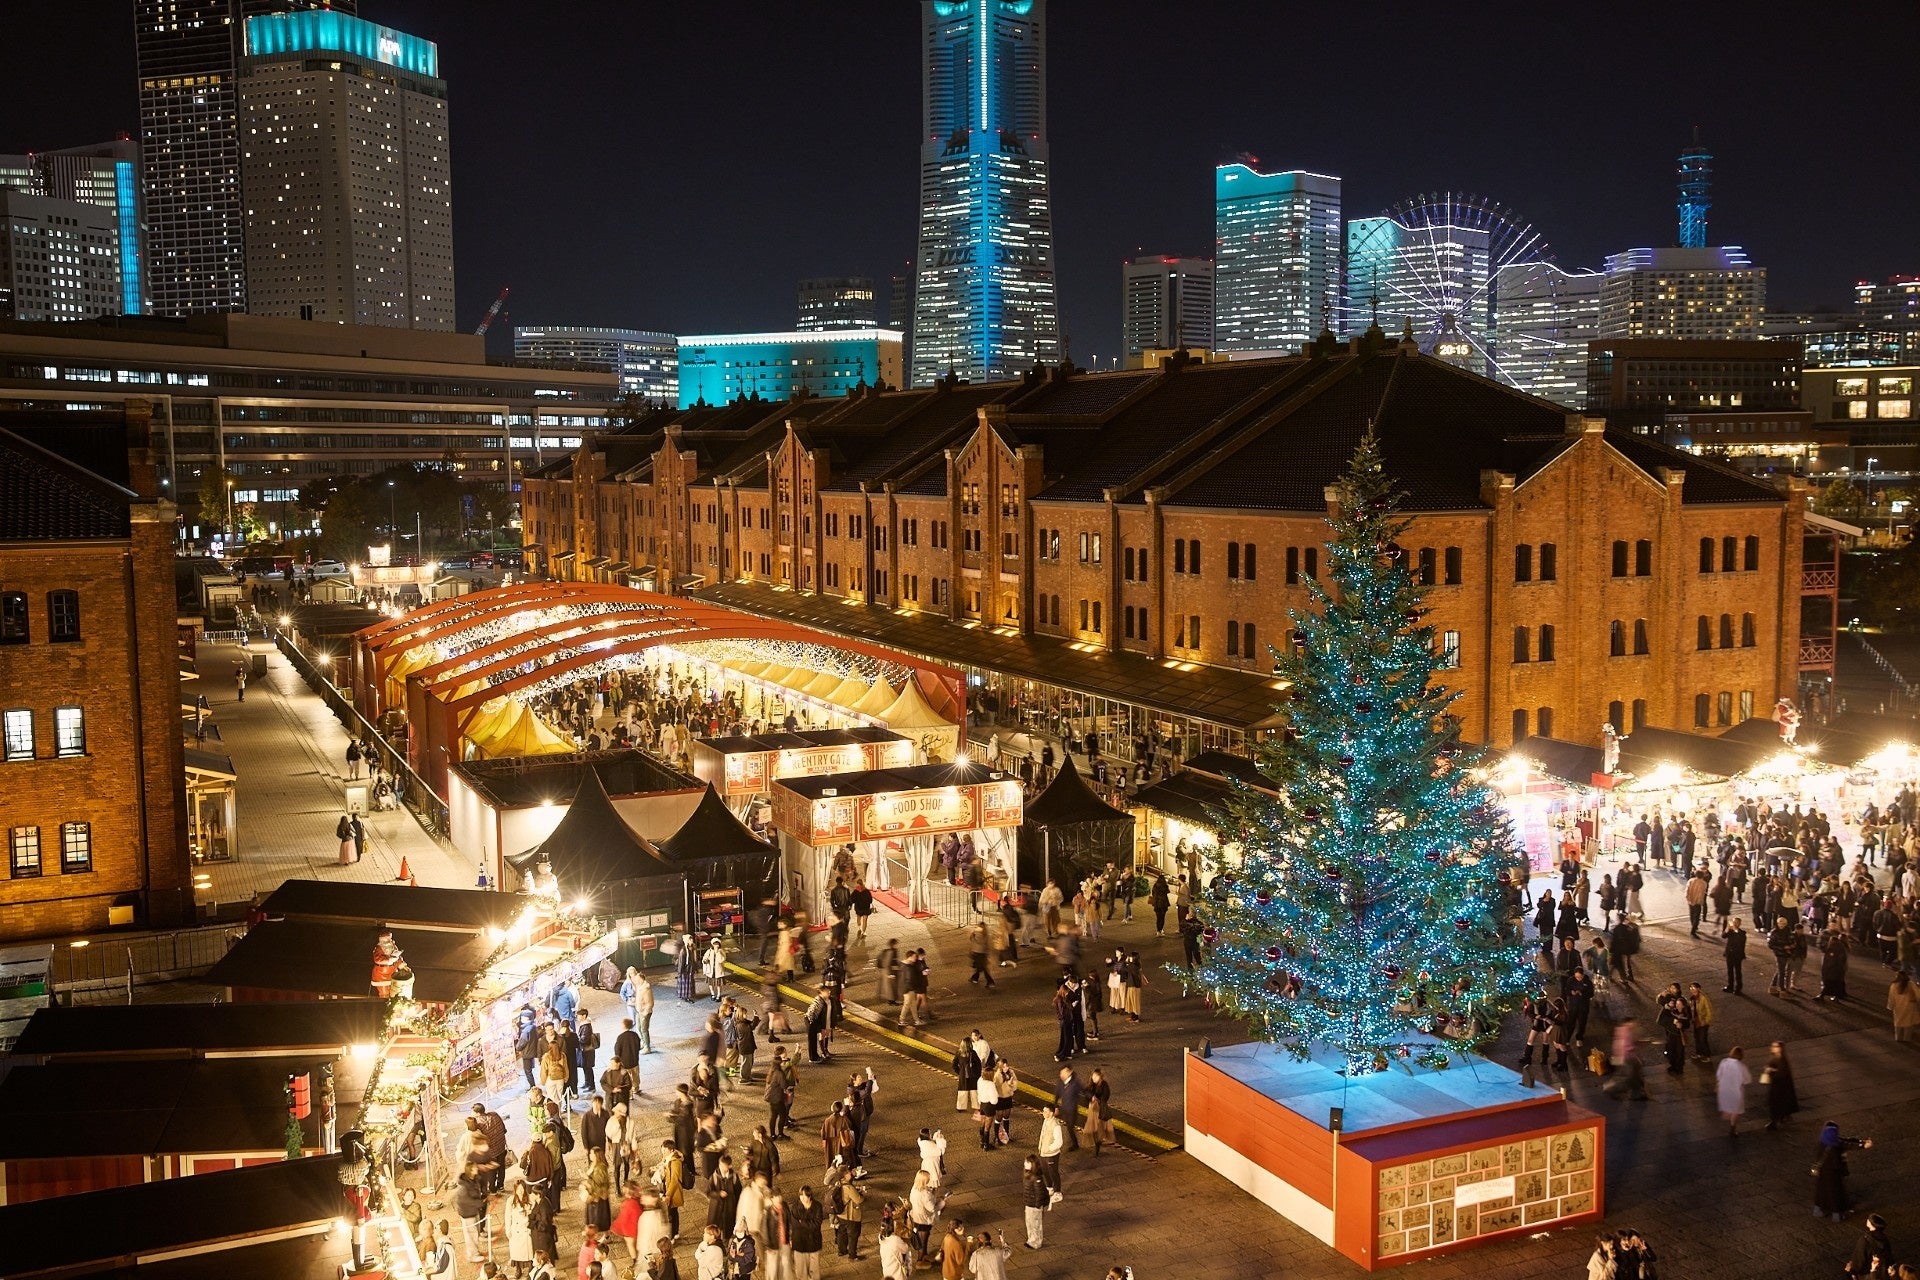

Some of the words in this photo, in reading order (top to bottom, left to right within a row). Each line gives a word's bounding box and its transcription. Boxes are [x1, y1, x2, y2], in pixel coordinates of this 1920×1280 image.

[1440, 345, 1469, 355] 20:15
[830, 754, 850, 766] GATE
[893, 799, 916, 815] FOOD
[920, 798, 943, 811] SHOP
[1557, 1142, 1568, 1152] 25
[1384, 1241, 1389, 1250] 8
